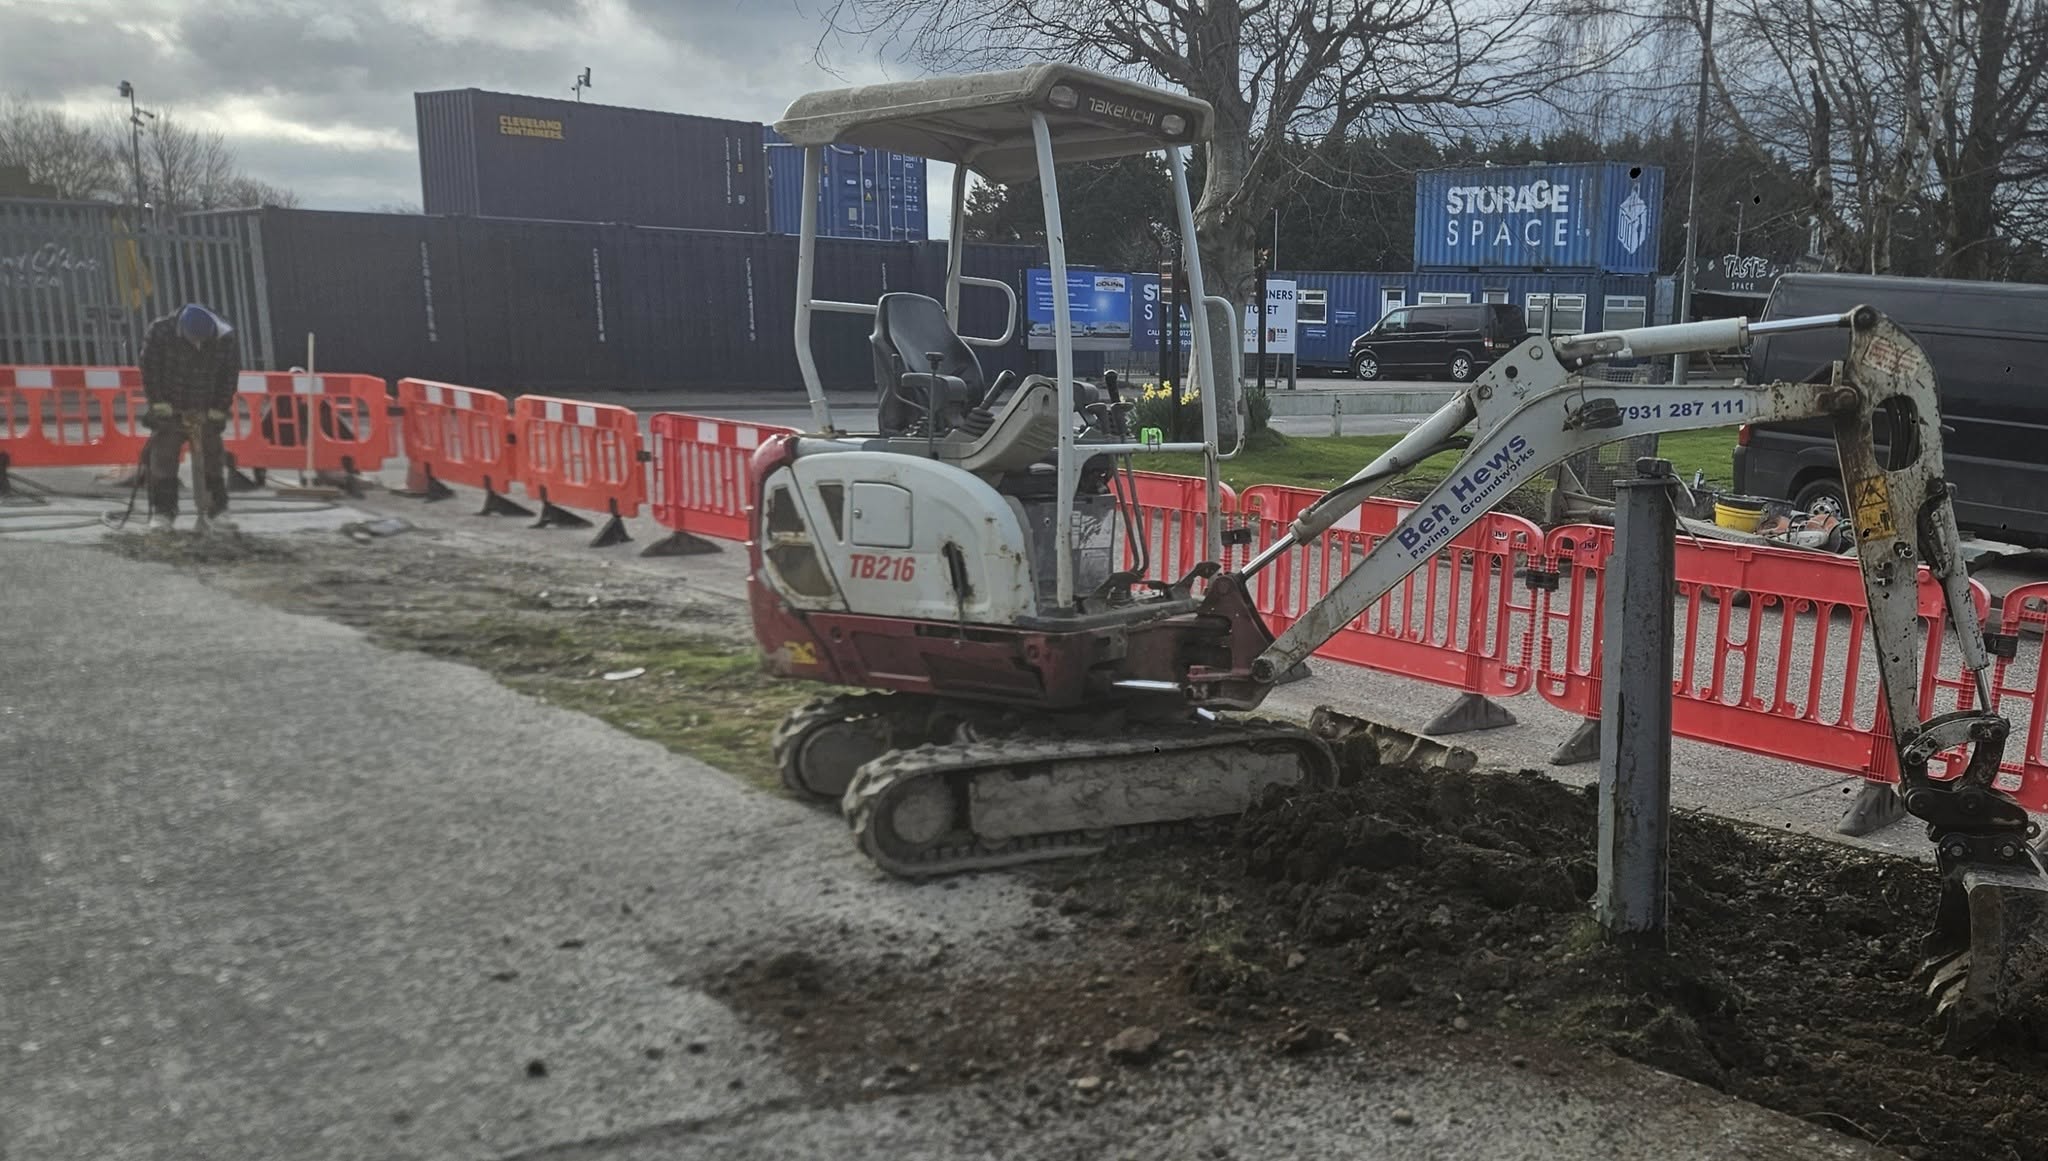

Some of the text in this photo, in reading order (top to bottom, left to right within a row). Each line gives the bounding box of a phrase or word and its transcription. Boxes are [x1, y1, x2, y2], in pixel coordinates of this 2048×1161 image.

[499, 115, 561, 130] CLEVELAND
[1446, 180, 1570, 214] STORAGE
[1446, 219, 1567, 246] SPACE
[1723, 254, 1768, 278] TASTE
[1731, 282, 1754, 290] SPACE
[1267, 305, 1278, 314] ET
[1619, 400, 1743, 420] 7931 287 111
[1398, 435, 1526, 550] Ben Hews
[1410, 448, 1535, 559] Paving & Groundworks
[850, 554, 916, 582] TB216
